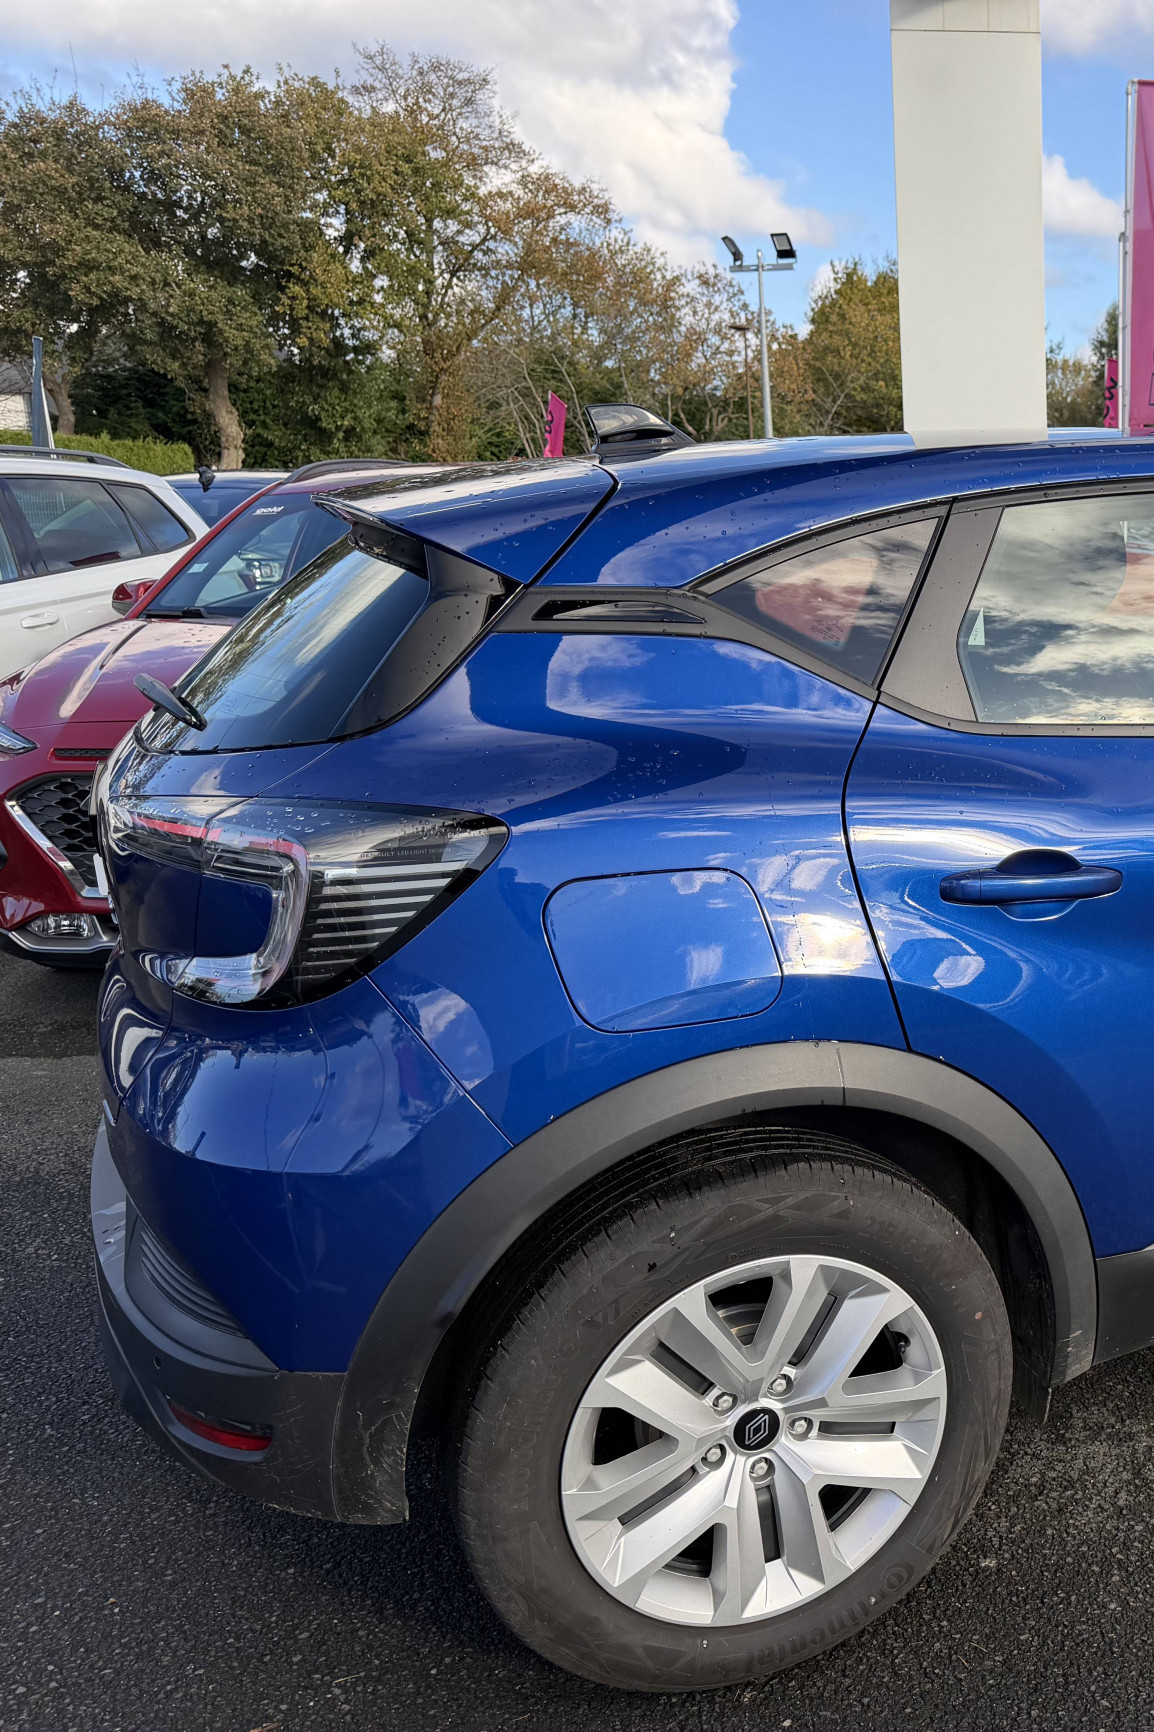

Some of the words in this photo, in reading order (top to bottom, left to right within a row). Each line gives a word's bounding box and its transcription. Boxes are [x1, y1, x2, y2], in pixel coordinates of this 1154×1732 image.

[252, 506, 285, 515] gold
[360, 851, 395, 859] RENAULT
[746, 1561, 916, 1675] Continental
